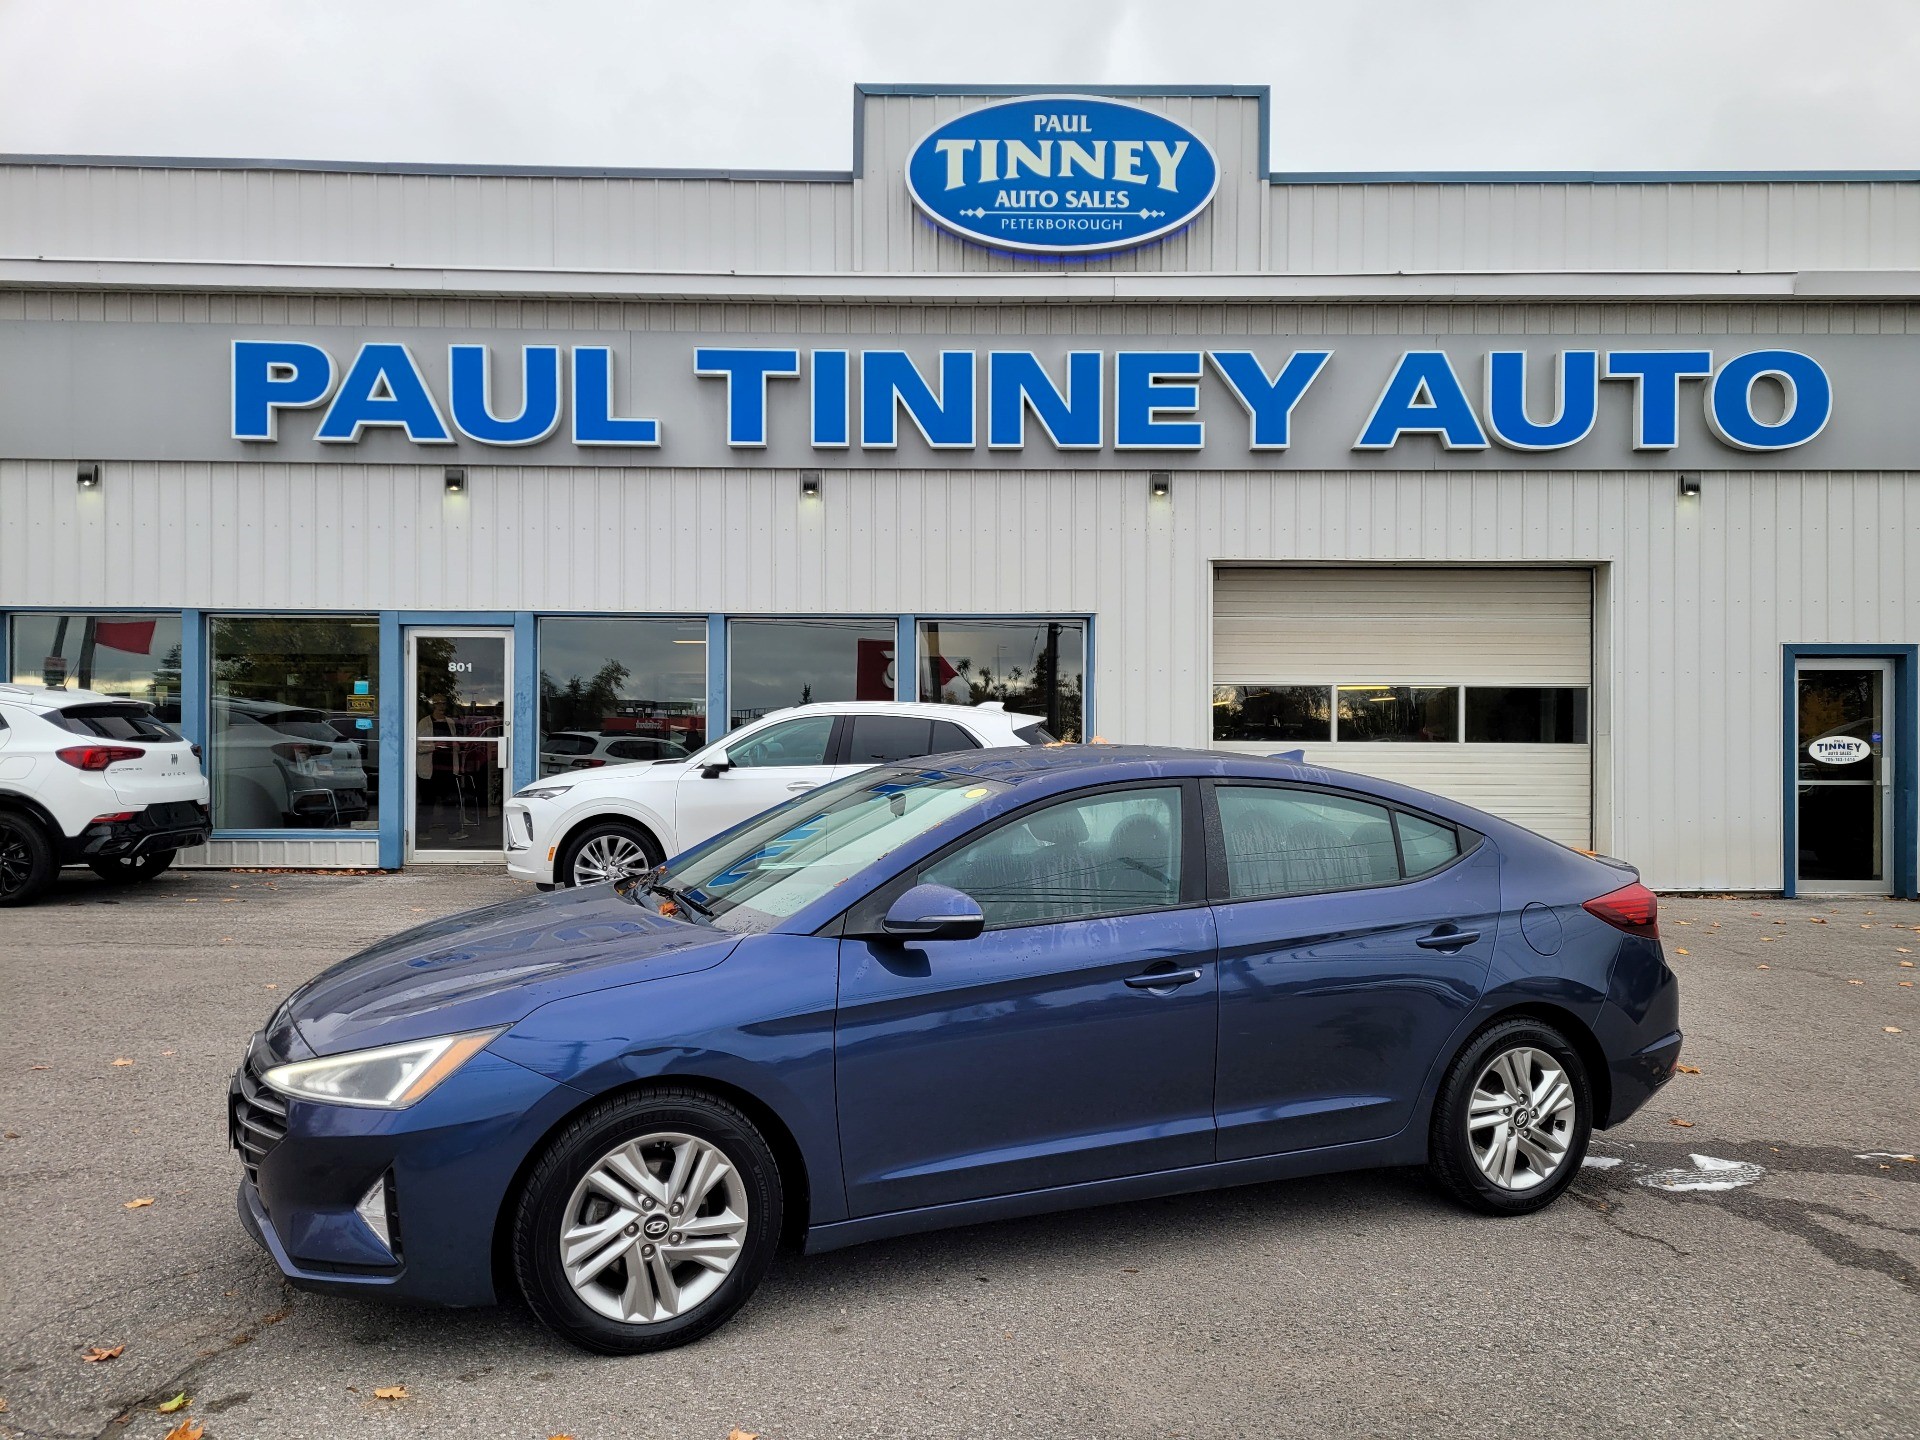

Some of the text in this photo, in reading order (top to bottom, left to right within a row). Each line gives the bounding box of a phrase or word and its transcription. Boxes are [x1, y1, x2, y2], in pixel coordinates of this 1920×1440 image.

[1034, 114, 1092, 132] PAUL
[935, 139, 1190, 193] TINNEY
[994, 190, 1130, 208] AUTO SALES
[1001, 218, 1123, 231] PETERBOROUGH
[231, 339, 1834, 452] PAUL TINNEY AUTO
[447, 662, 472, 673] 801
[1817, 743, 1862, 753] TINNEY
